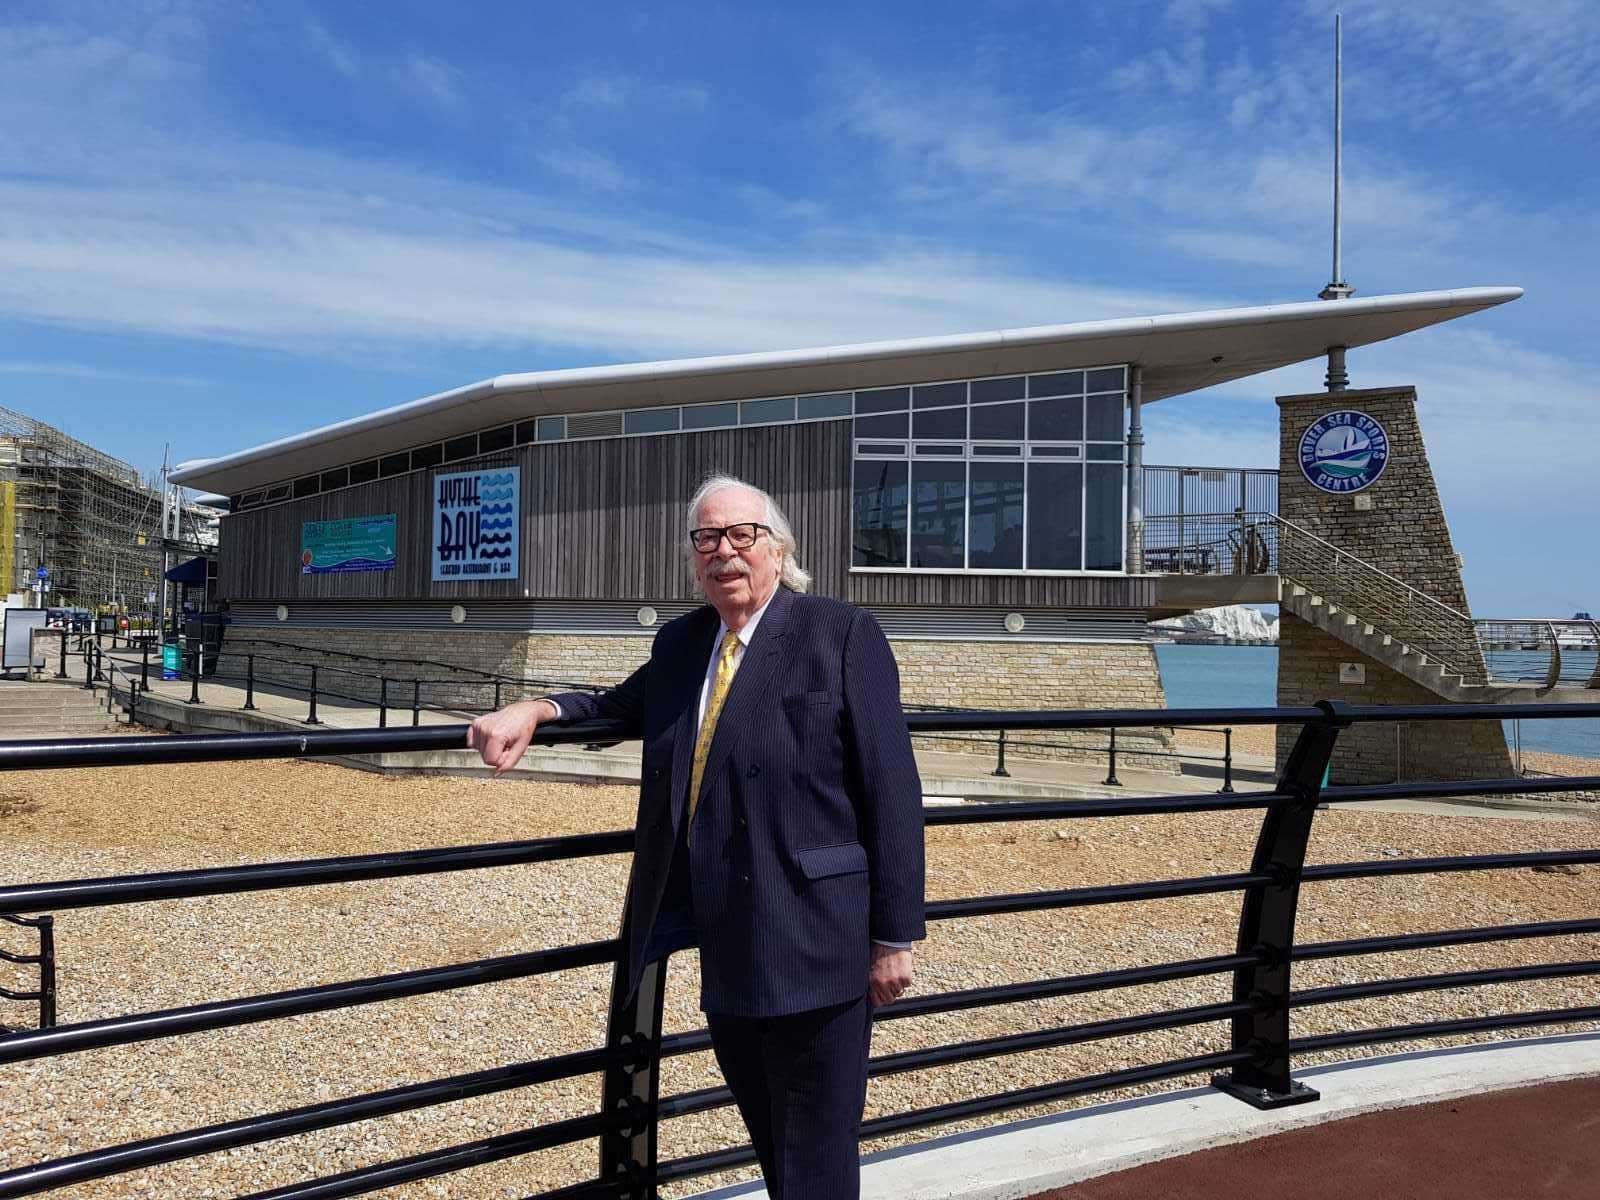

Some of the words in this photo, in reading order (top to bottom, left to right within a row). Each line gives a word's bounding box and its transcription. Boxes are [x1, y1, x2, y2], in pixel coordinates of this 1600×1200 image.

[1302, 424, 1326, 463] DOVER
[1328, 414, 1351, 427] SEA
[1356, 416, 1386, 460] SPORTS
[438, 476, 480, 509] HYTHE
[1317, 472, 1369, 490] CENTRE
[437, 510, 480, 561] BAY
